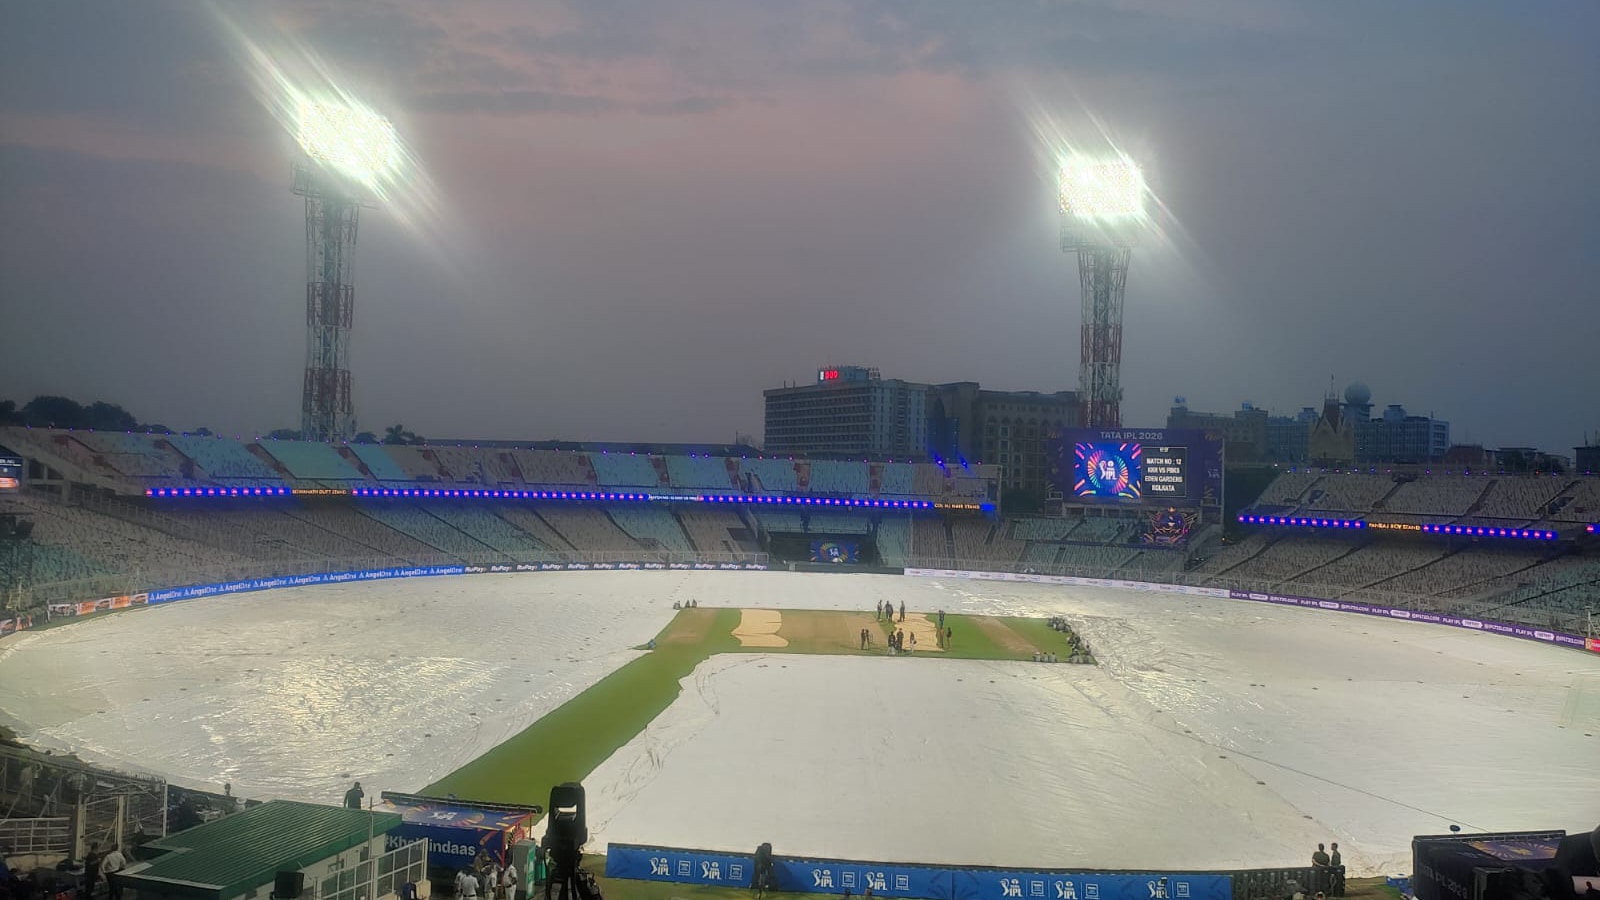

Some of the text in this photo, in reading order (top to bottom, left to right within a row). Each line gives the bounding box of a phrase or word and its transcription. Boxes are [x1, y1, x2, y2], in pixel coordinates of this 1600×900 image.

[1100, 431, 1163, 441] TATA IPL 2026
[1144, 475, 1183, 483] EDEN GARDENS
[1151, 484, 1176, 492] KOLKATA
[657, 866, 671, 876] IPL
[708, 869, 722, 880] IPL
[820, 878, 835, 888] IPL
[874, 880, 888, 891] IPL
[1009, 887, 1023, 897] IPL
[1063, 889, 1078, 900] IPL
[1156, 889, 1170, 899] IPL
